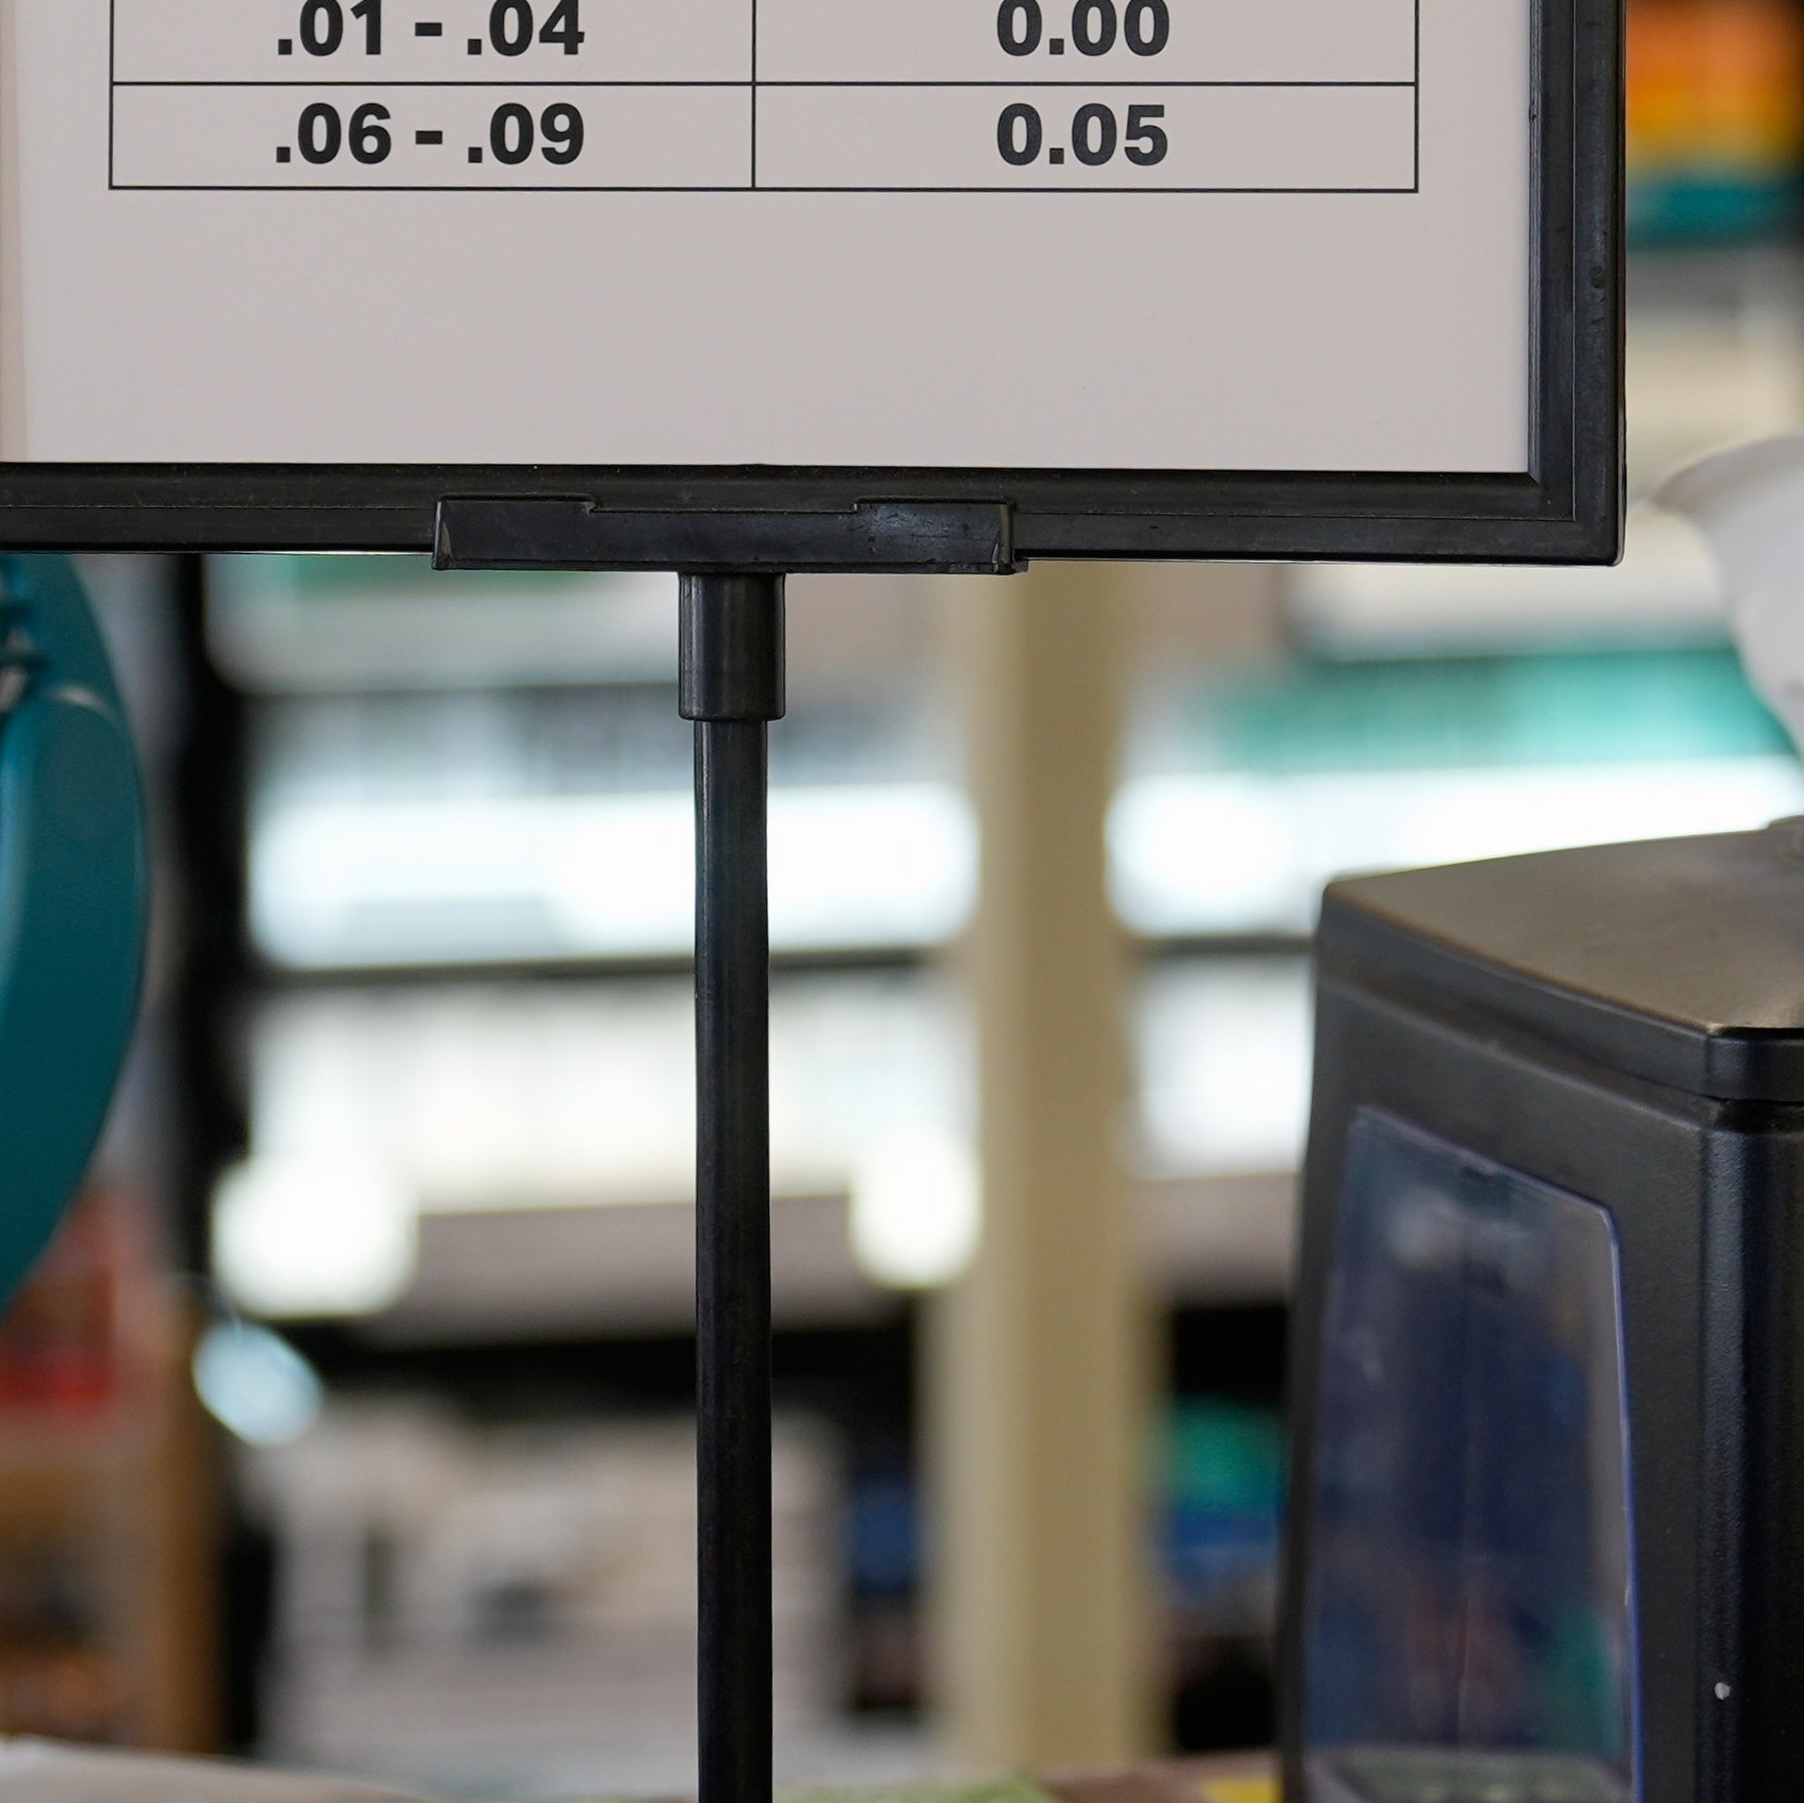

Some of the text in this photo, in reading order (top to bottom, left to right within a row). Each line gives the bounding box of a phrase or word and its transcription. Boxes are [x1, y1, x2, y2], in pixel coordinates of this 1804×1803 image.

[415, 22, 442, 36] -
[276, 103, 584, 165] .06 - .09
[997, 103, 1167, 166] 0.05
